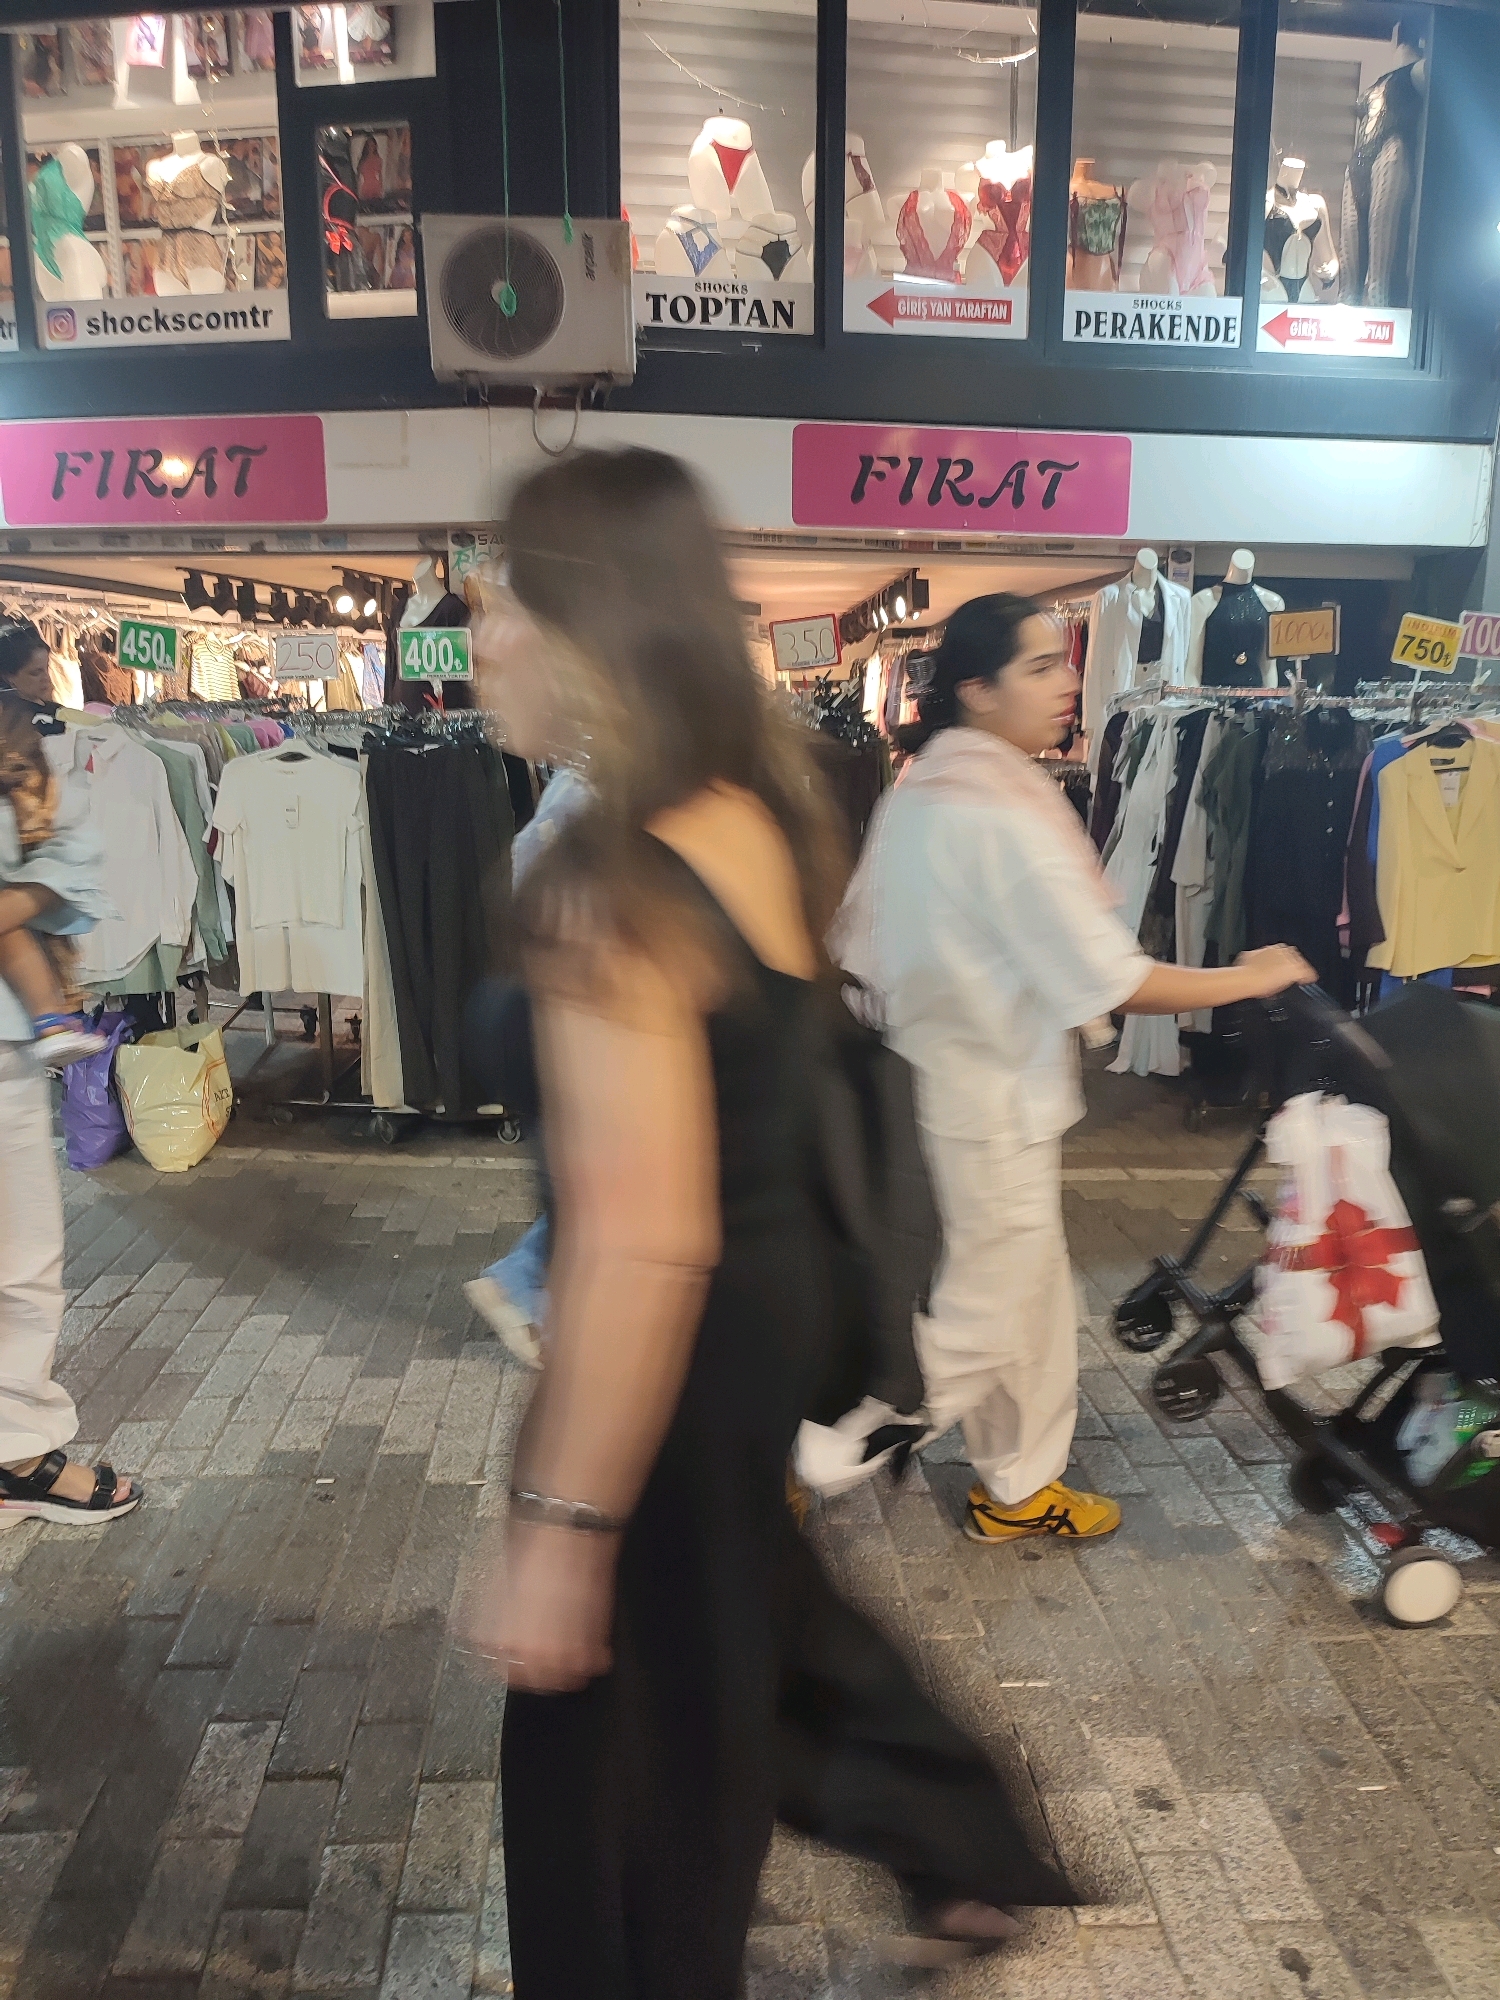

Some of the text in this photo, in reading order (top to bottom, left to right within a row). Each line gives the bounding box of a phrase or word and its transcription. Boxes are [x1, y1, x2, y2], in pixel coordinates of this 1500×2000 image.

[694, 281, 748, 295] SHOCKS
[86, 305, 274, 336] shockscomtr
[645, 292, 796, 330] TOPTAN
[898, 296, 1008, 321] GİRİŞ YAN TARAFTAN
[1132, 299, 1183, 311] SHOCKS
[1074, 310, 1238, 343] PERAKENDE
[51, 444, 268, 501] FIRAT
[850, 455, 1080, 510] FIRAT
[278, 641, 335, 672] 250
[782, 627, 836, 664] 350
